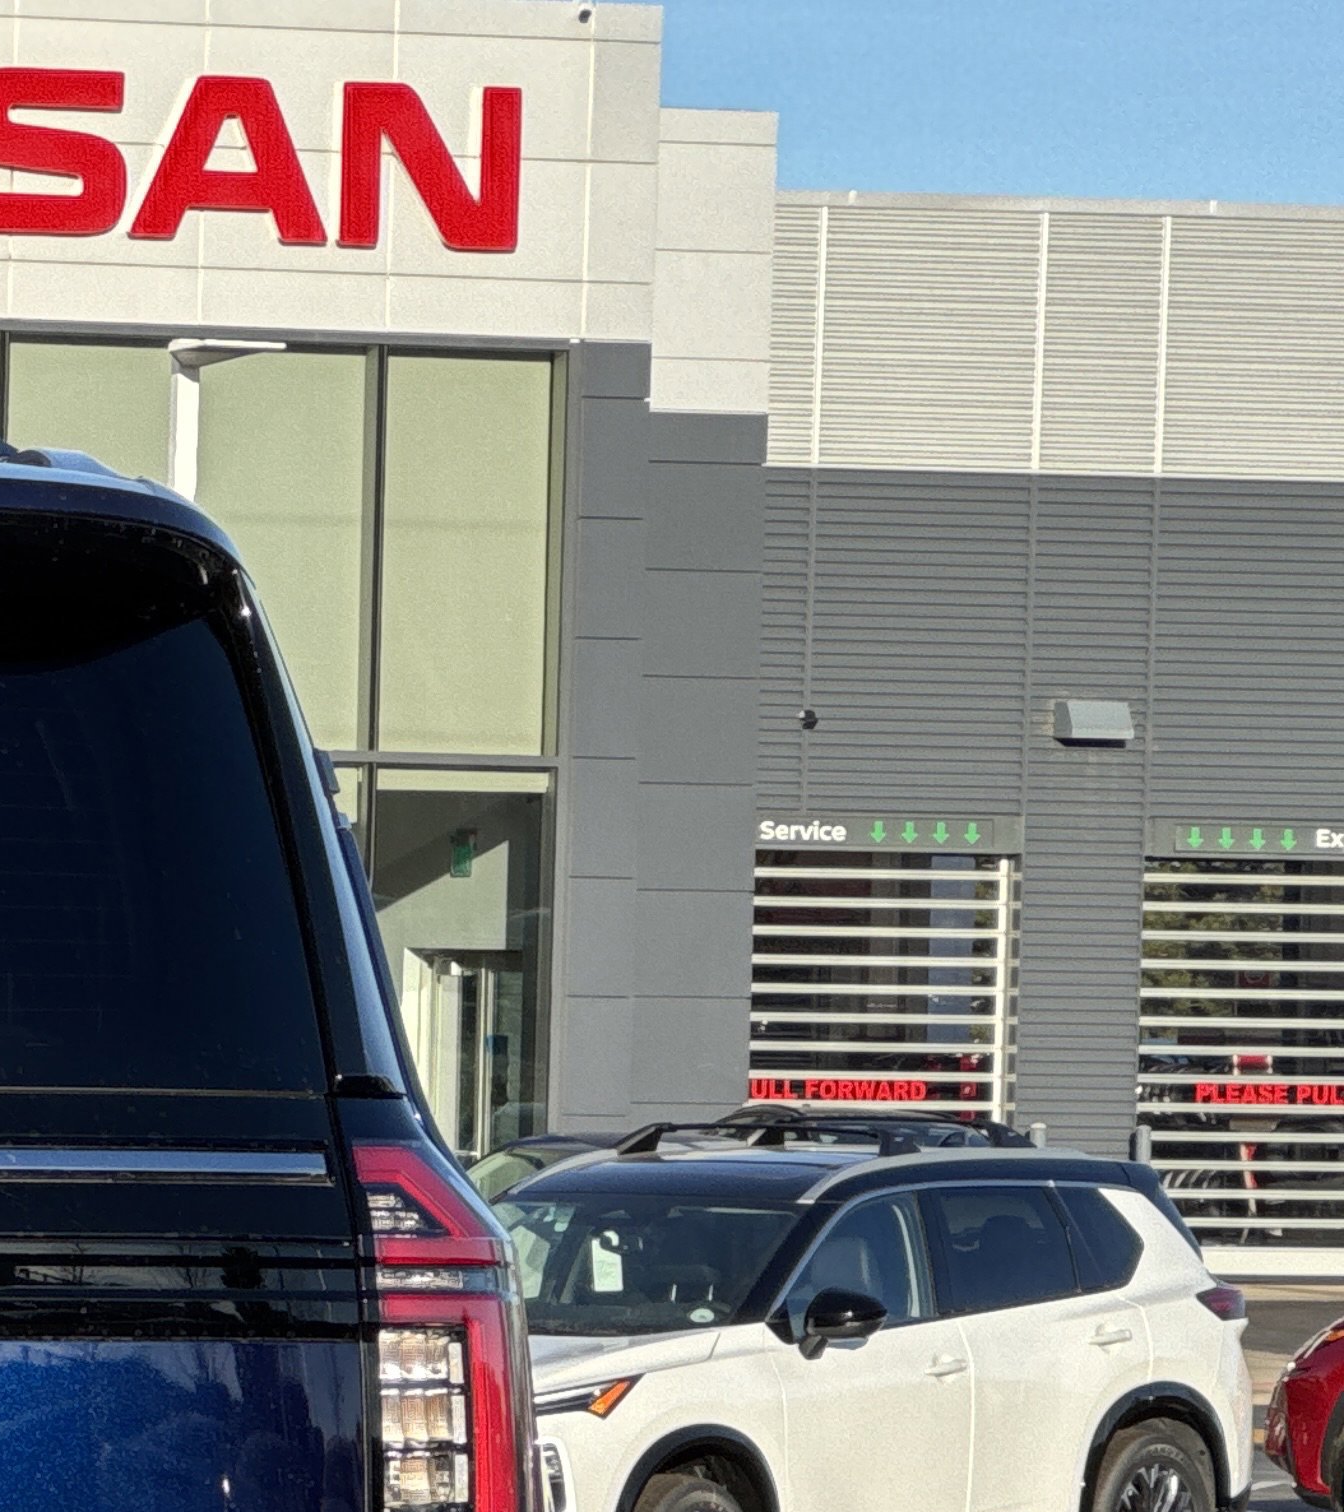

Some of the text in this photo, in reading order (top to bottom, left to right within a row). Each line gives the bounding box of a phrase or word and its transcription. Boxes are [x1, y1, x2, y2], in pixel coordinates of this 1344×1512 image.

[759, 820, 847, 841] Service
[805, 1079, 926, 1101] FORWARD
[1196, 1082, 1289, 1104] PLEASE
